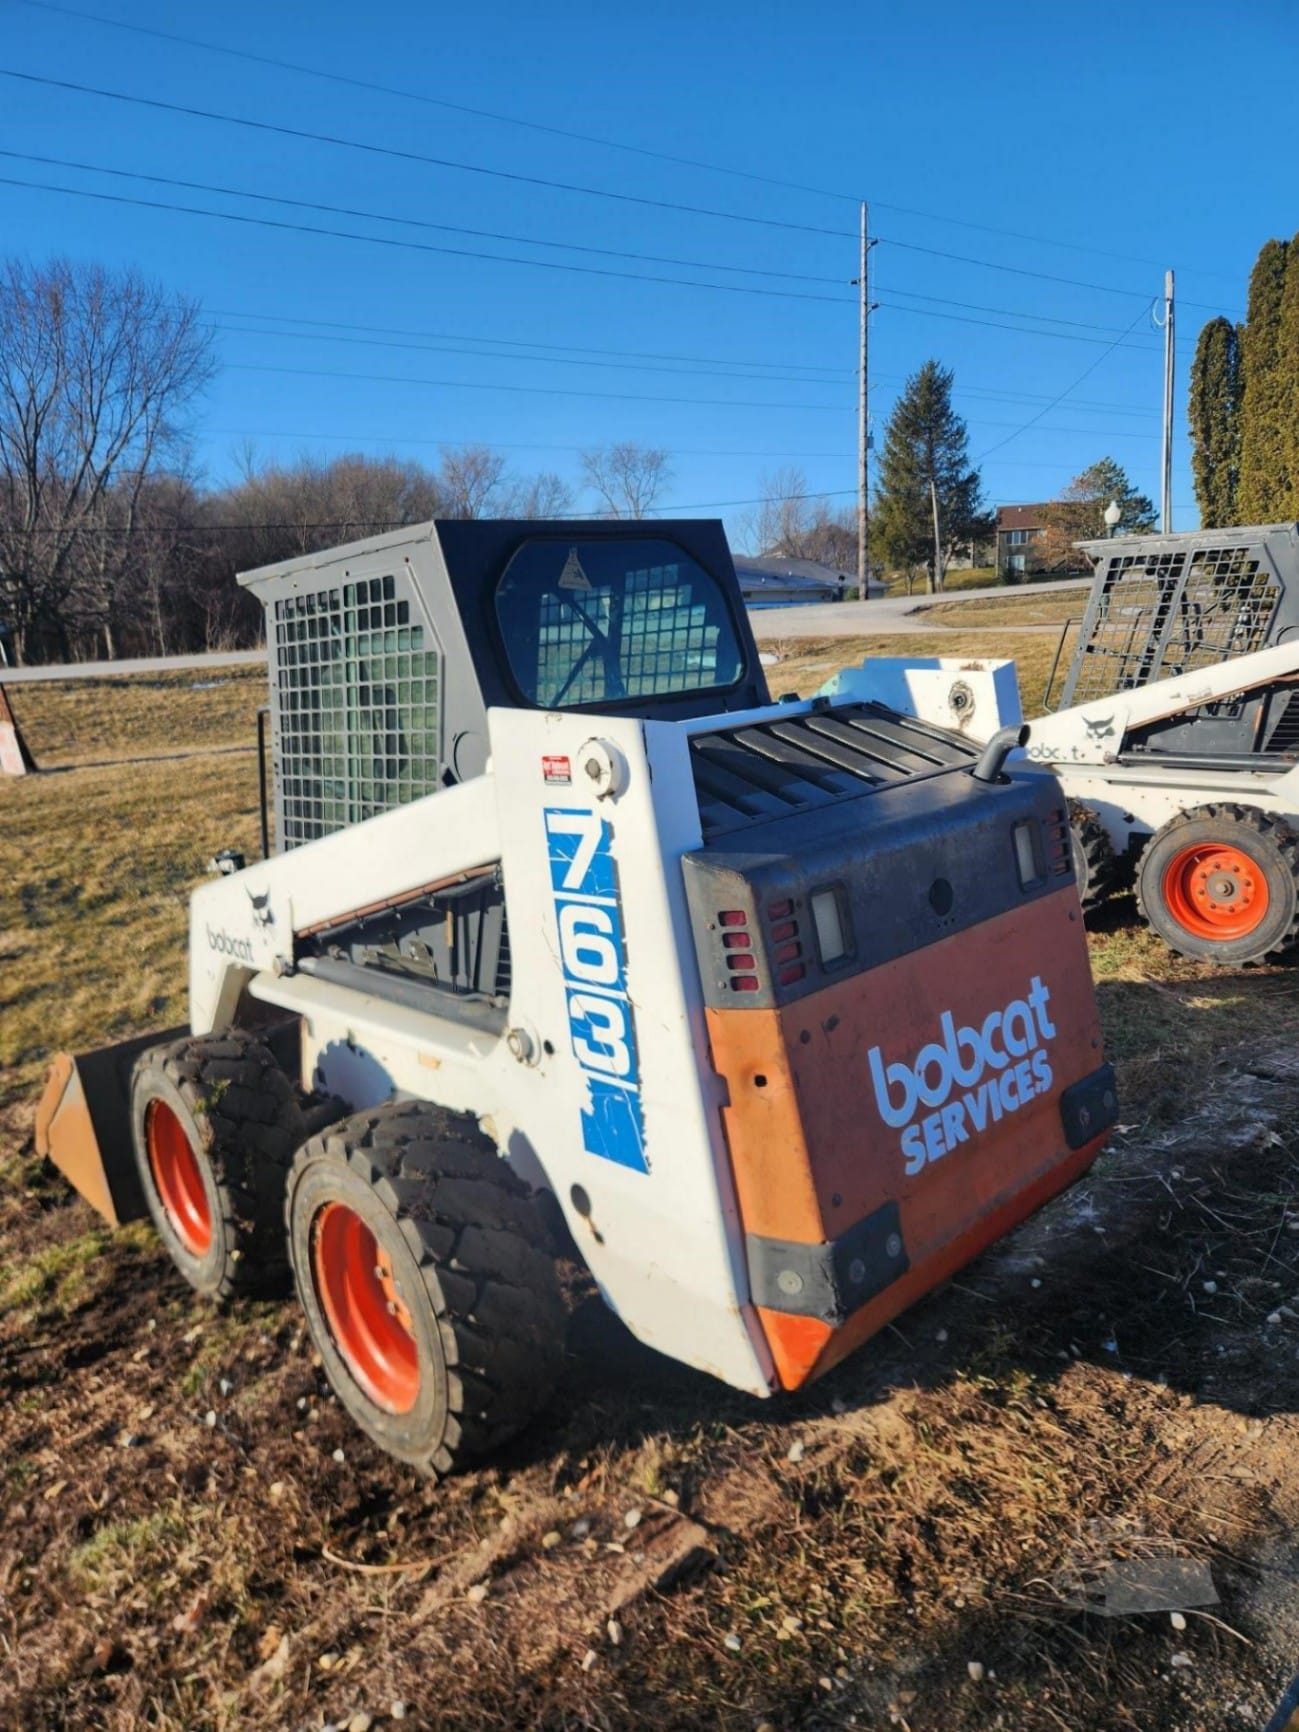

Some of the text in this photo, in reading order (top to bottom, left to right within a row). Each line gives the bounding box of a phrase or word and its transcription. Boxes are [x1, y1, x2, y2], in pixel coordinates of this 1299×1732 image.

[1027, 742, 1079, 761] obct
[546, 810, 631, 1078] 763
[867, 975, 1056, 1128] bobcat
[901, 1049, 1053, 1176] SERVICES
